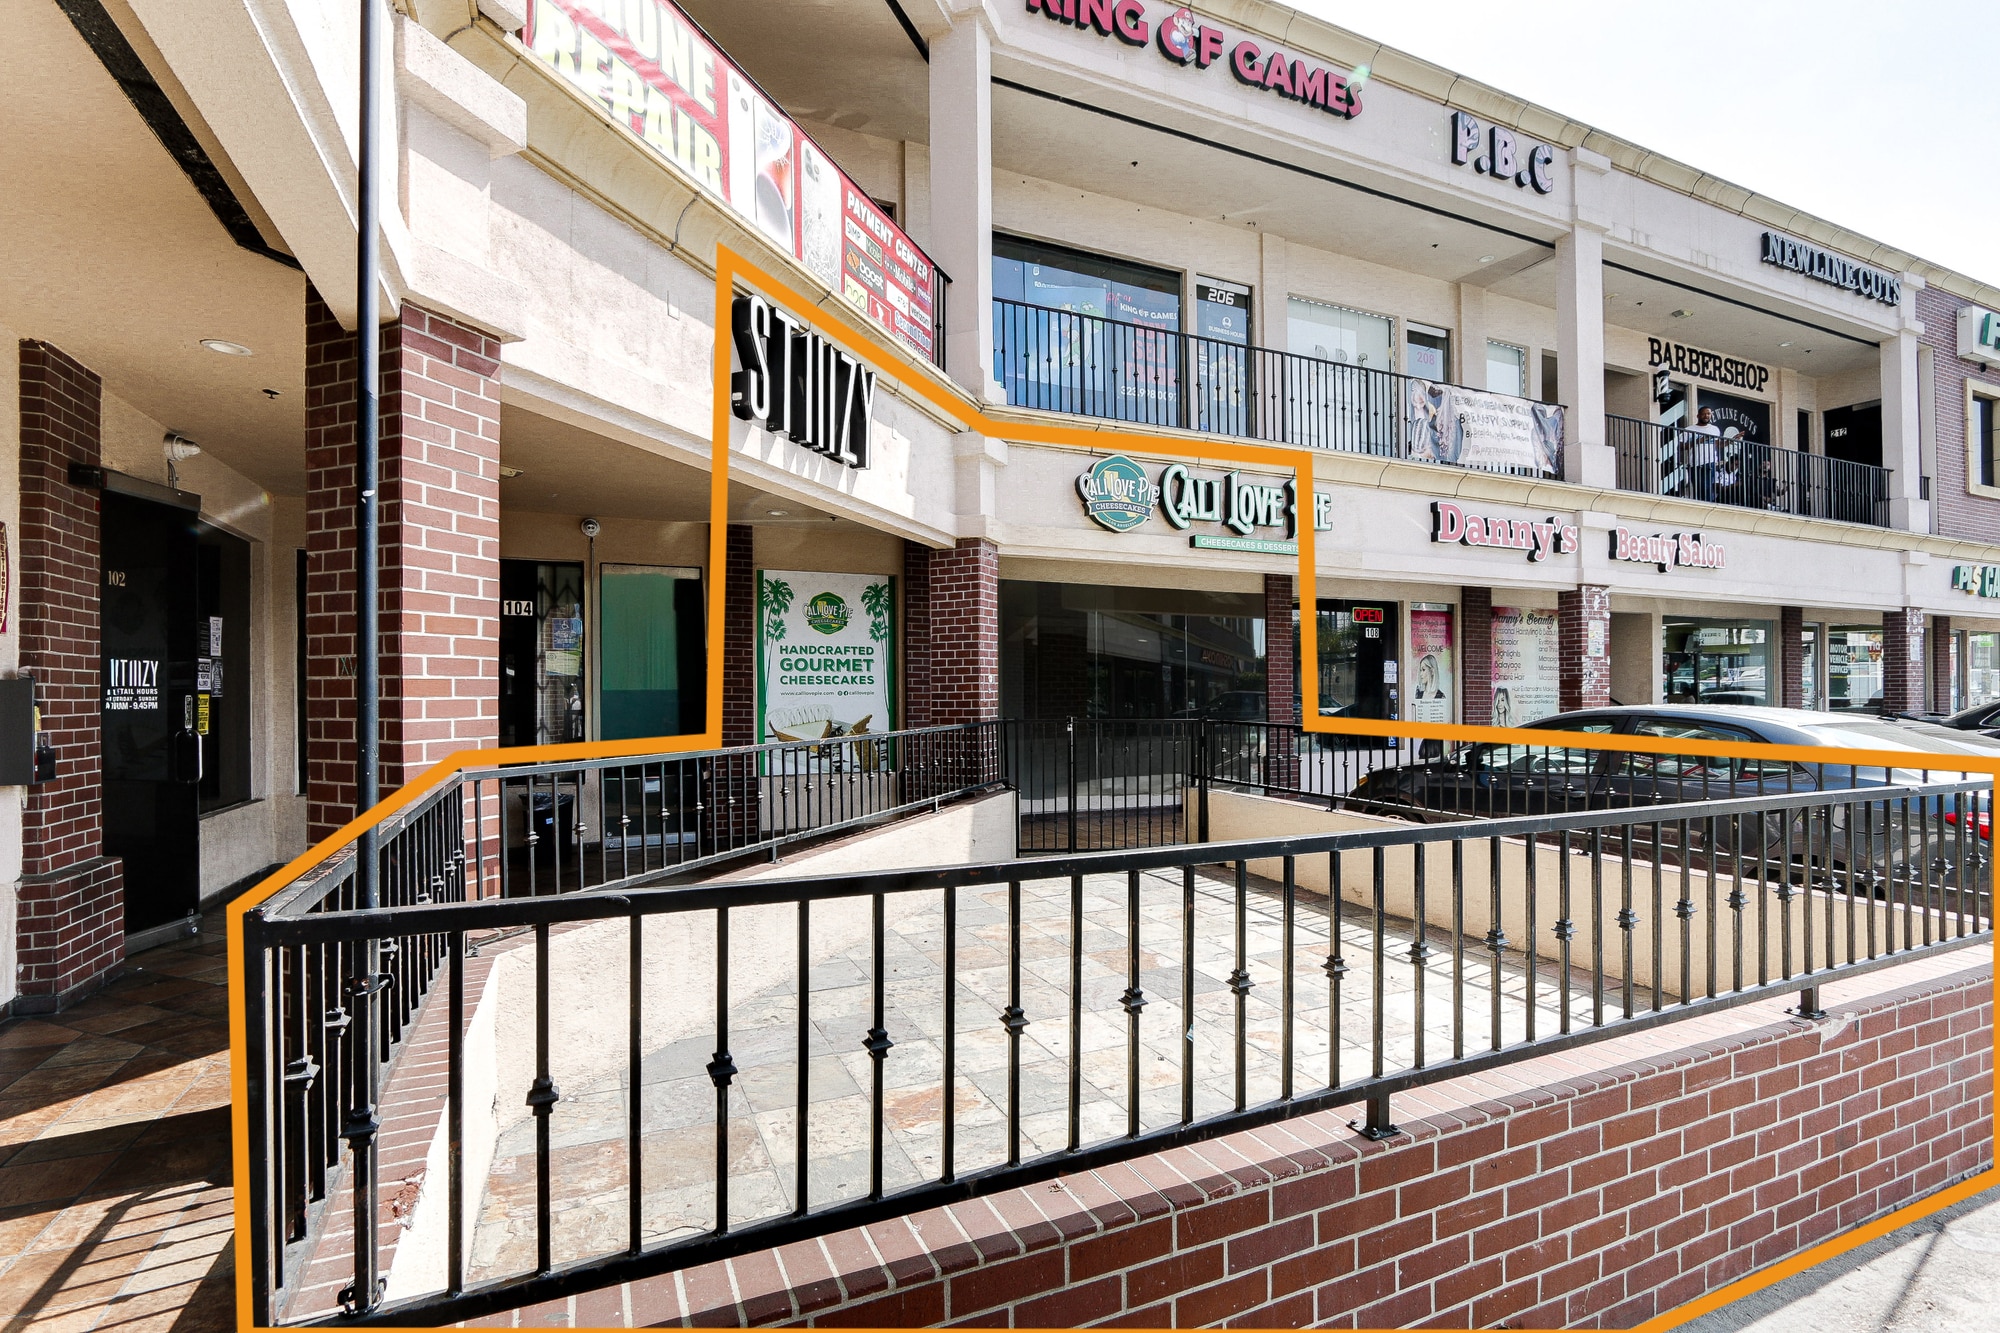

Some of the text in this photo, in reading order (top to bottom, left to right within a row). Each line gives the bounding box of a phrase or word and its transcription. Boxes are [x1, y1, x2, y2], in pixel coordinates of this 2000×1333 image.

[1230, 41, 1363, 120] GAMES
[533, 0, 724, 198] REPAIR
[847, 190, 928, 282] PAYMENT CENTER
[859, 257, 884, 290] boost
[1763, 232, 1901, 306] NEWLINE CUTS
[1207, 288, 1235, 306] 206
[910, 304, 931, 327] verizon
[1120, 303, 1138, 315] KING
[1150, 312, 1177, 320] GAMES
[1416, 351, 1435, 365] 208
[1648, 337, 1769, 392] BARBERSHOP
[1740, 413, 1758, 435] CUTS
[1079, 472, 1160, 506] CALI LOVE PIE
[1095, 502, 1146, 514] CHEESECAKES
[1160, 463, 1333, 539] CALI LOVE IE
[1432, 501, 1578, 563] Danny's
[1200, 538, 1256, 549] CHEESECAKES
[1609, 526, 1726, 573] Beauty Salon
[107, 570, 126, 587] 102
[505, 601, 532, 615] 104
[1354, 608, 1383, 623] OPEN
[1526, 612, 1555, 630] Beauty
[1366, 627, 1379, 638] 108
[779, 645, 875, 656] HANDCRAFTED
[1830, 644, 1848, 653] MOTOR
[779, 657, 875, 672] GOURMET
[1830, 655, 1849, 664] VEHICLE
[1830, 665, 1849, 674] SERVICES
[779, 675, 875, 685] CHEESECAKES
